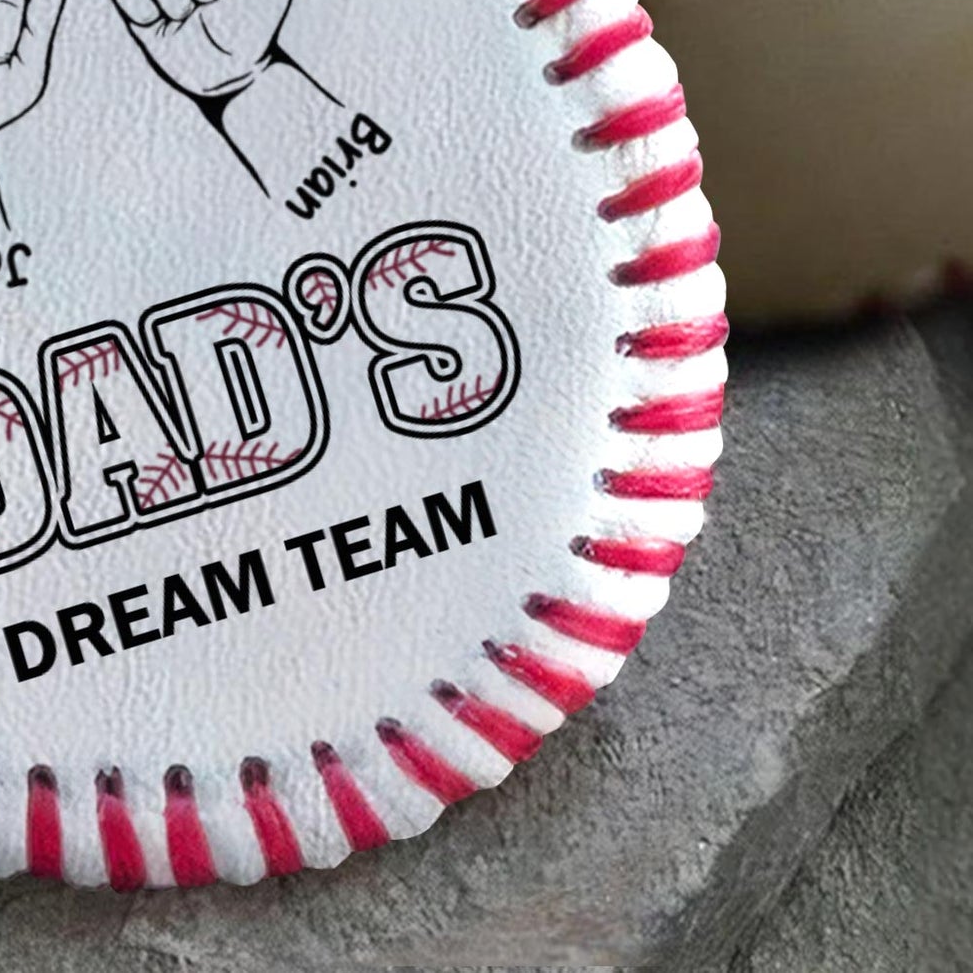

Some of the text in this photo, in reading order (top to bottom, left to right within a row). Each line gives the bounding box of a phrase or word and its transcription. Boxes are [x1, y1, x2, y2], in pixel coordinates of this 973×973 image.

[285, 112, 393, 220] Brian
[3, 480, 498, 683] DREAM TEAM
